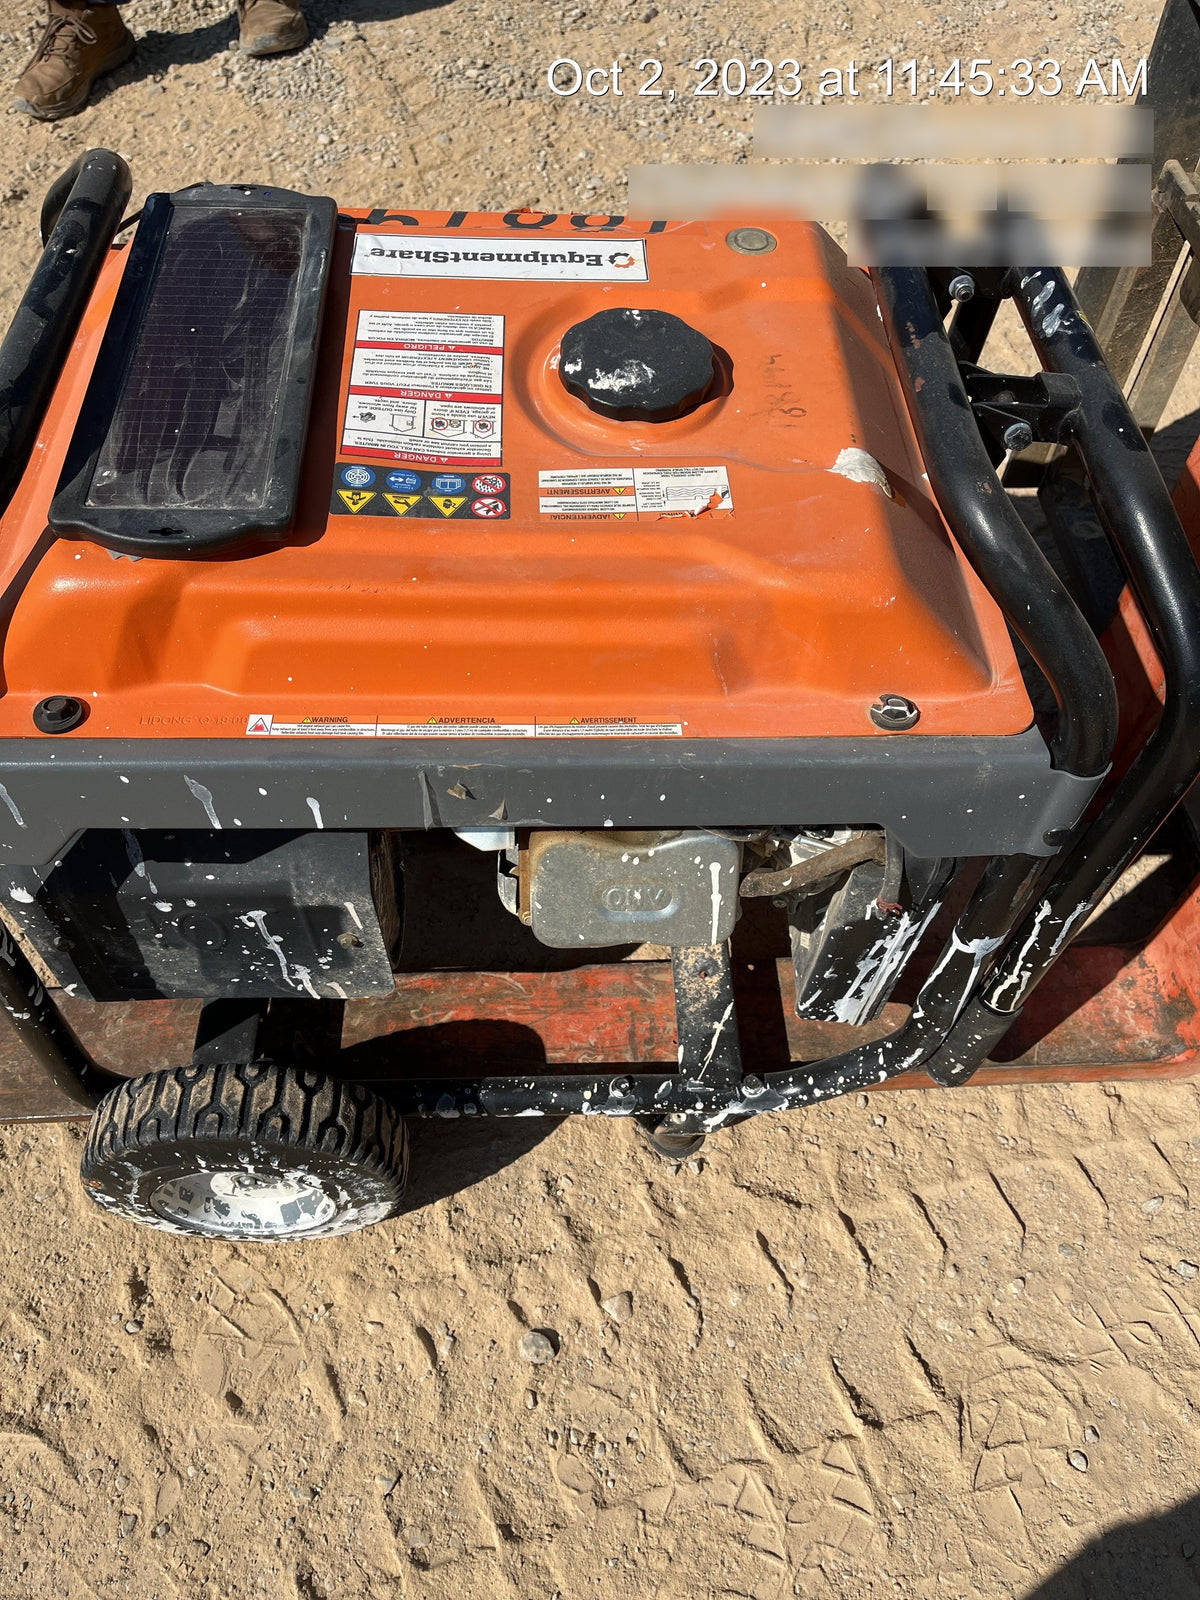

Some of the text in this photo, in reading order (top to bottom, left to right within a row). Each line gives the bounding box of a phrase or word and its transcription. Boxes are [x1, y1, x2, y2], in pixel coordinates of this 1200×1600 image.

[371, 248, 603, 267] EquipmentShare
[400, 390, 441, 398] DANGER
[394, 452, 437, 463] DANGER
